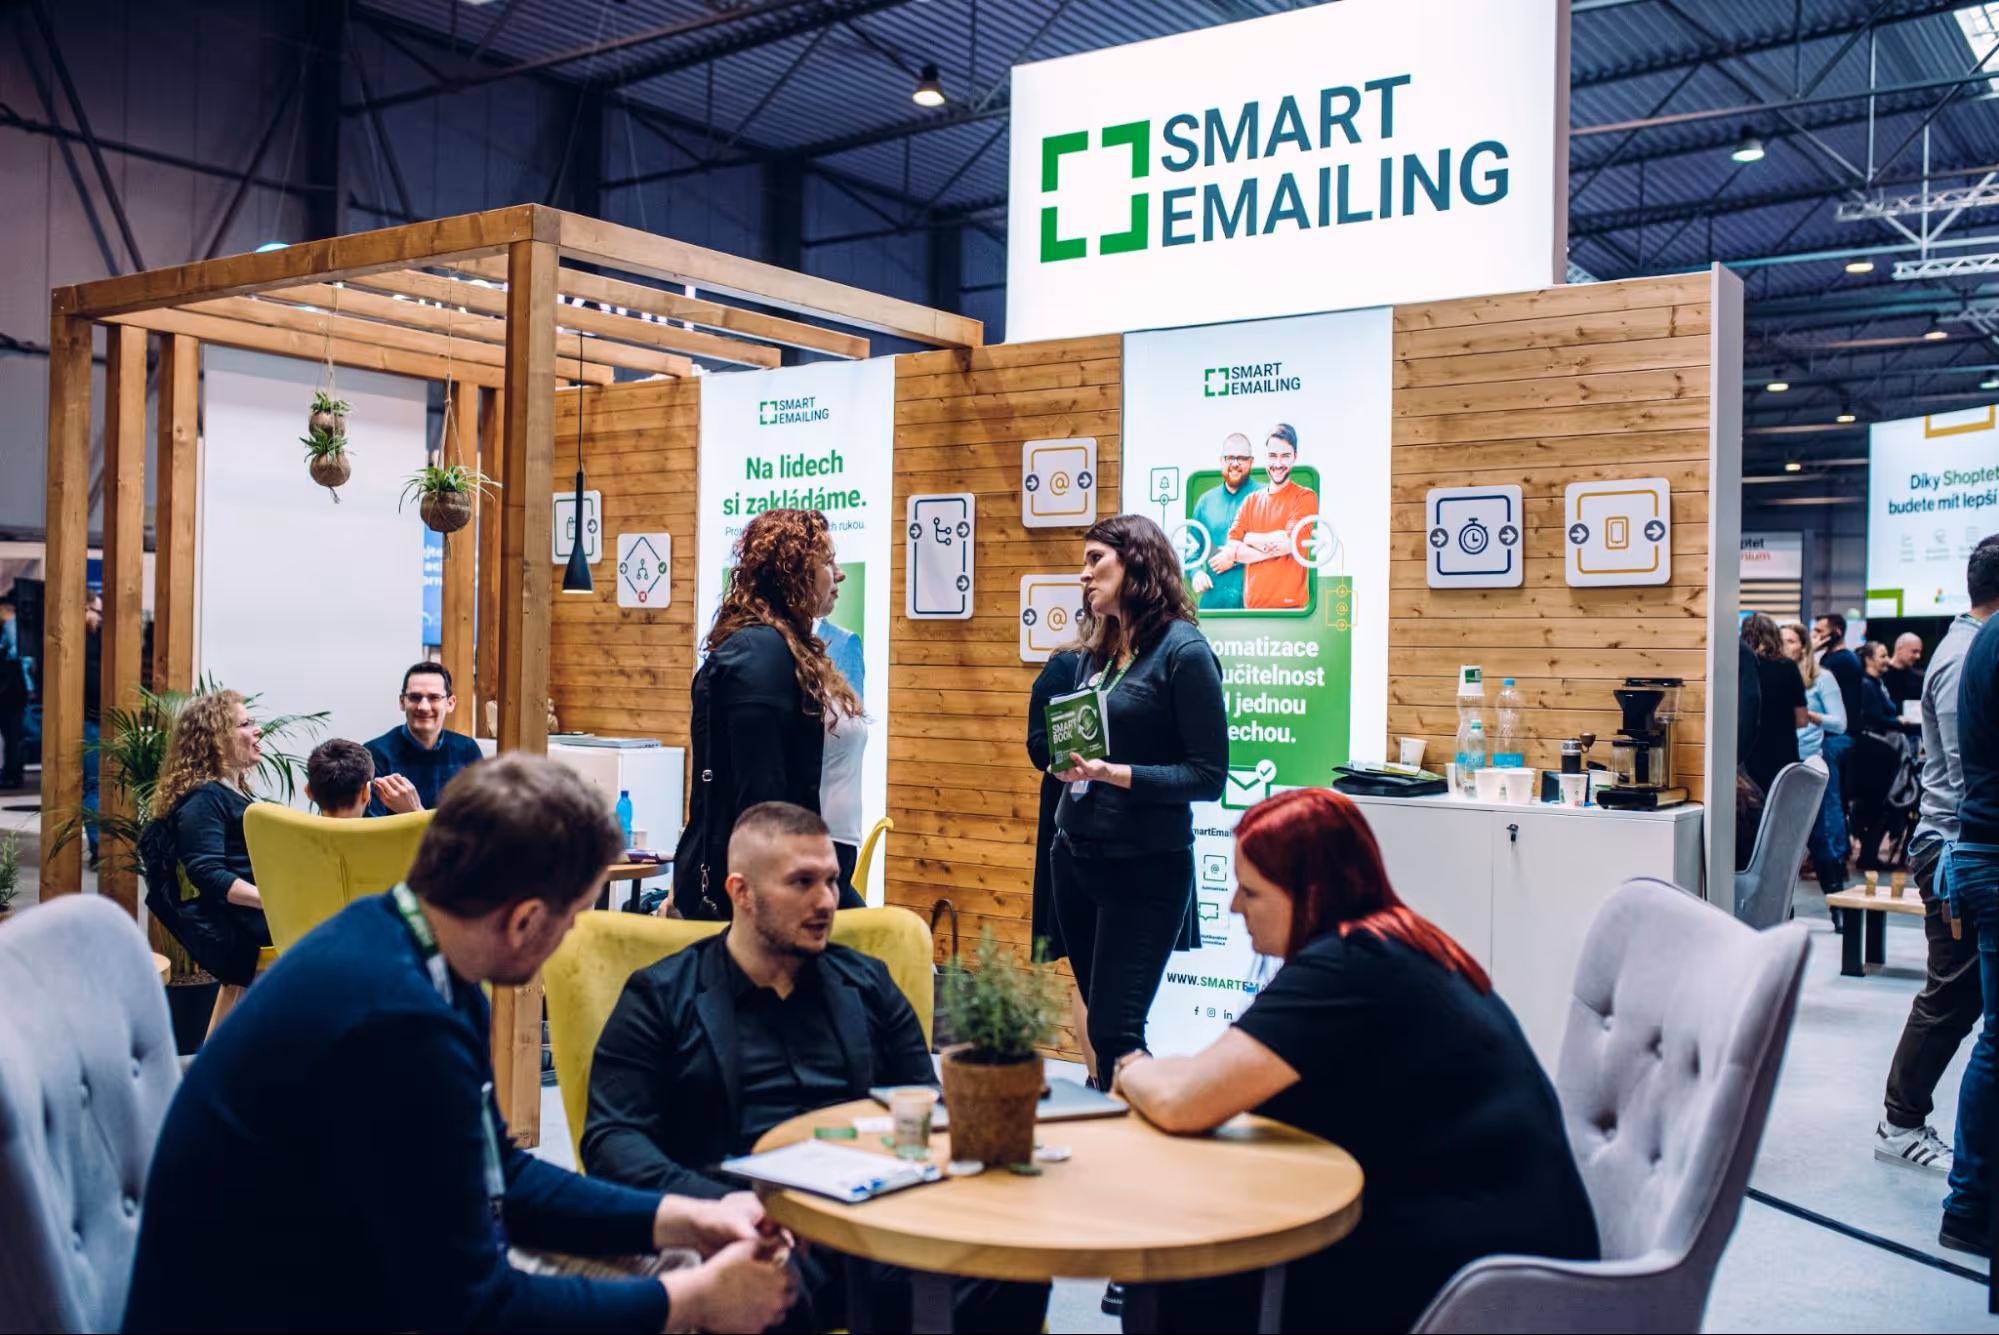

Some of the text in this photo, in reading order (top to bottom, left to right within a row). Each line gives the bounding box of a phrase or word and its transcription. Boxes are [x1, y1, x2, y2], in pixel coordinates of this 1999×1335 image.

[1160, 74, 1411, 173] SMART
[1161, 140, 1510, 247] EMAILING
[1231, 362, 1283, 380] SMART
[1231, 377, 1301, 395] EMAILING
[779, 397, 816, 411] SMART
[779, 409, 830, 424] EMAILING
[746, 449, 844, 480] Na lidech
[723, 486, 867, 516] si zakládáme.
[1888, 489, 1997, 515] budete mít lepší
[1209, 636, 1320, 657] omatizace
[1222, 663, 1325, 687] učitelnost
[1233, 691, 1307, 718] jednou
[1052, 718, 1077, 735] SMART
[1053, 729, 1073, 744] BOOK
[1228, 720, 1297, 743] echou.
[1193, 827, 1232, 837] martEmai
